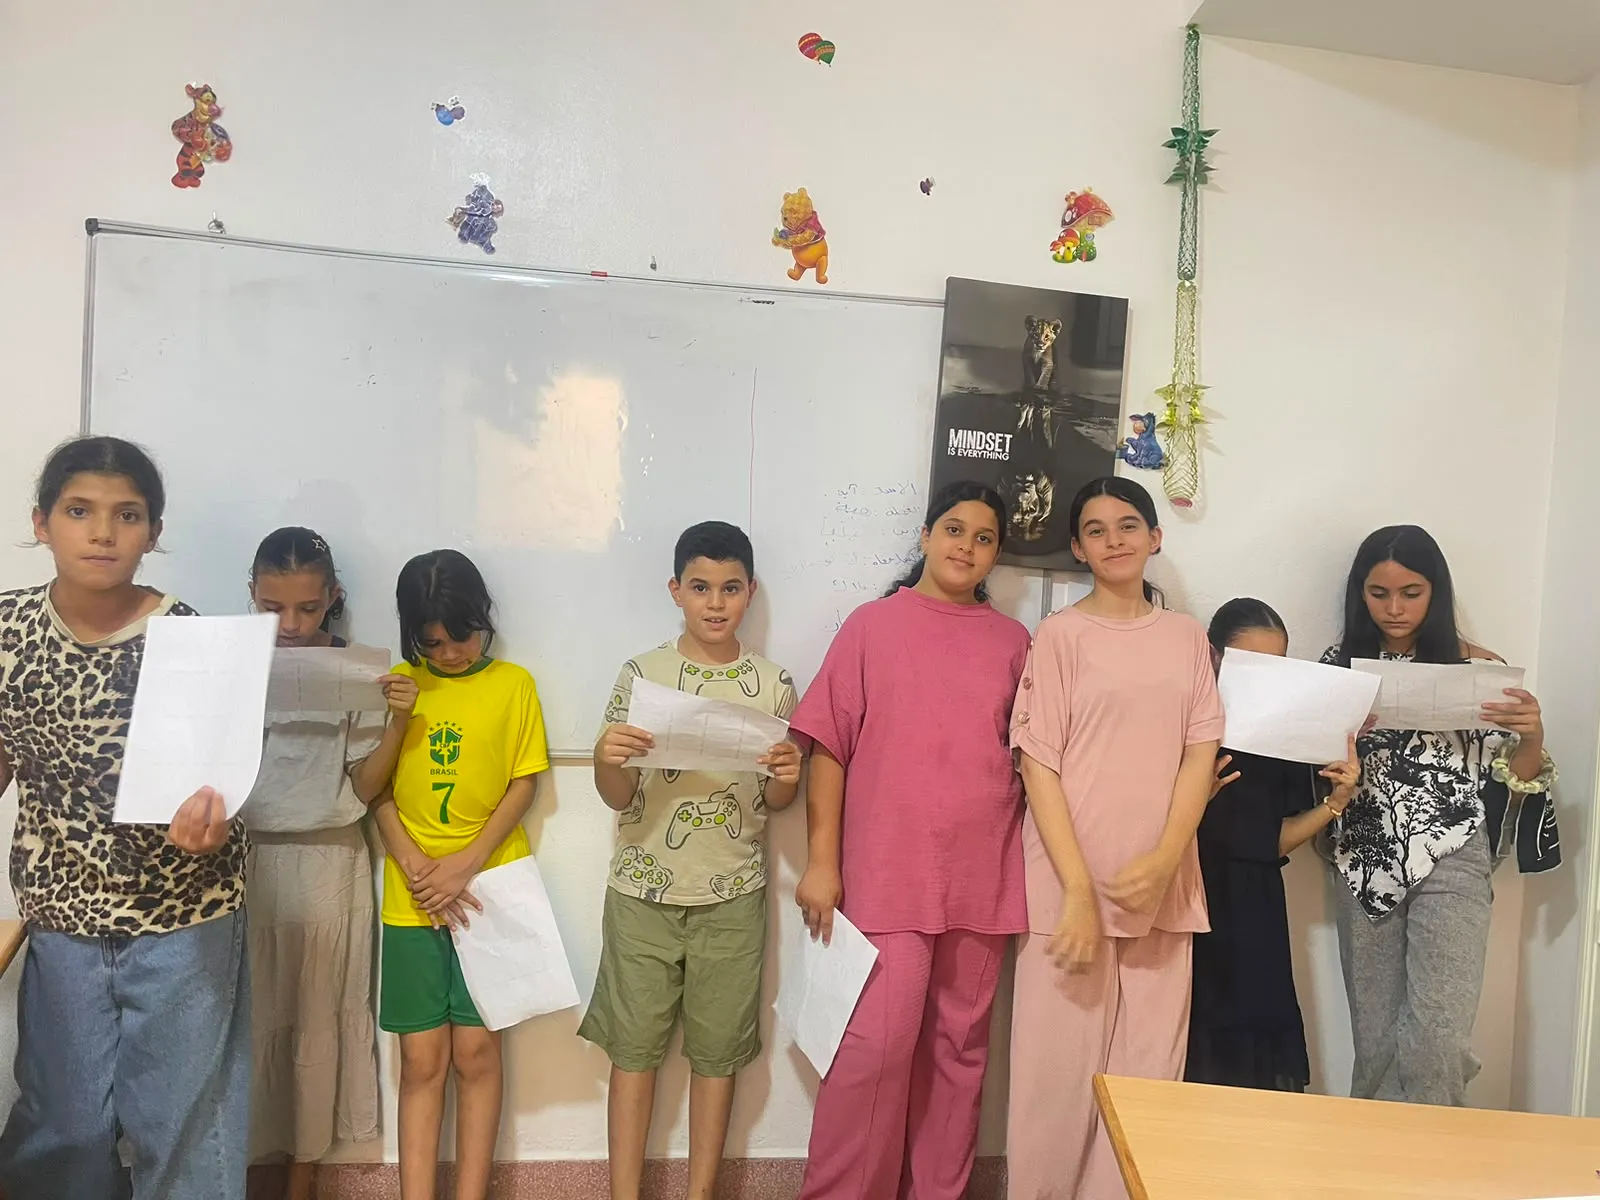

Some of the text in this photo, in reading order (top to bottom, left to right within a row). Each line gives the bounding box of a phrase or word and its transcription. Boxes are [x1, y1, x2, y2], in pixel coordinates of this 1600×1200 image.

[949, 428, 1013, 453] MINDSET
[947, 447, 1010, 461] IS EVERYTHING
[430, 768, 459, 776] BRASIL
[431, 782, 456, 825] 7
